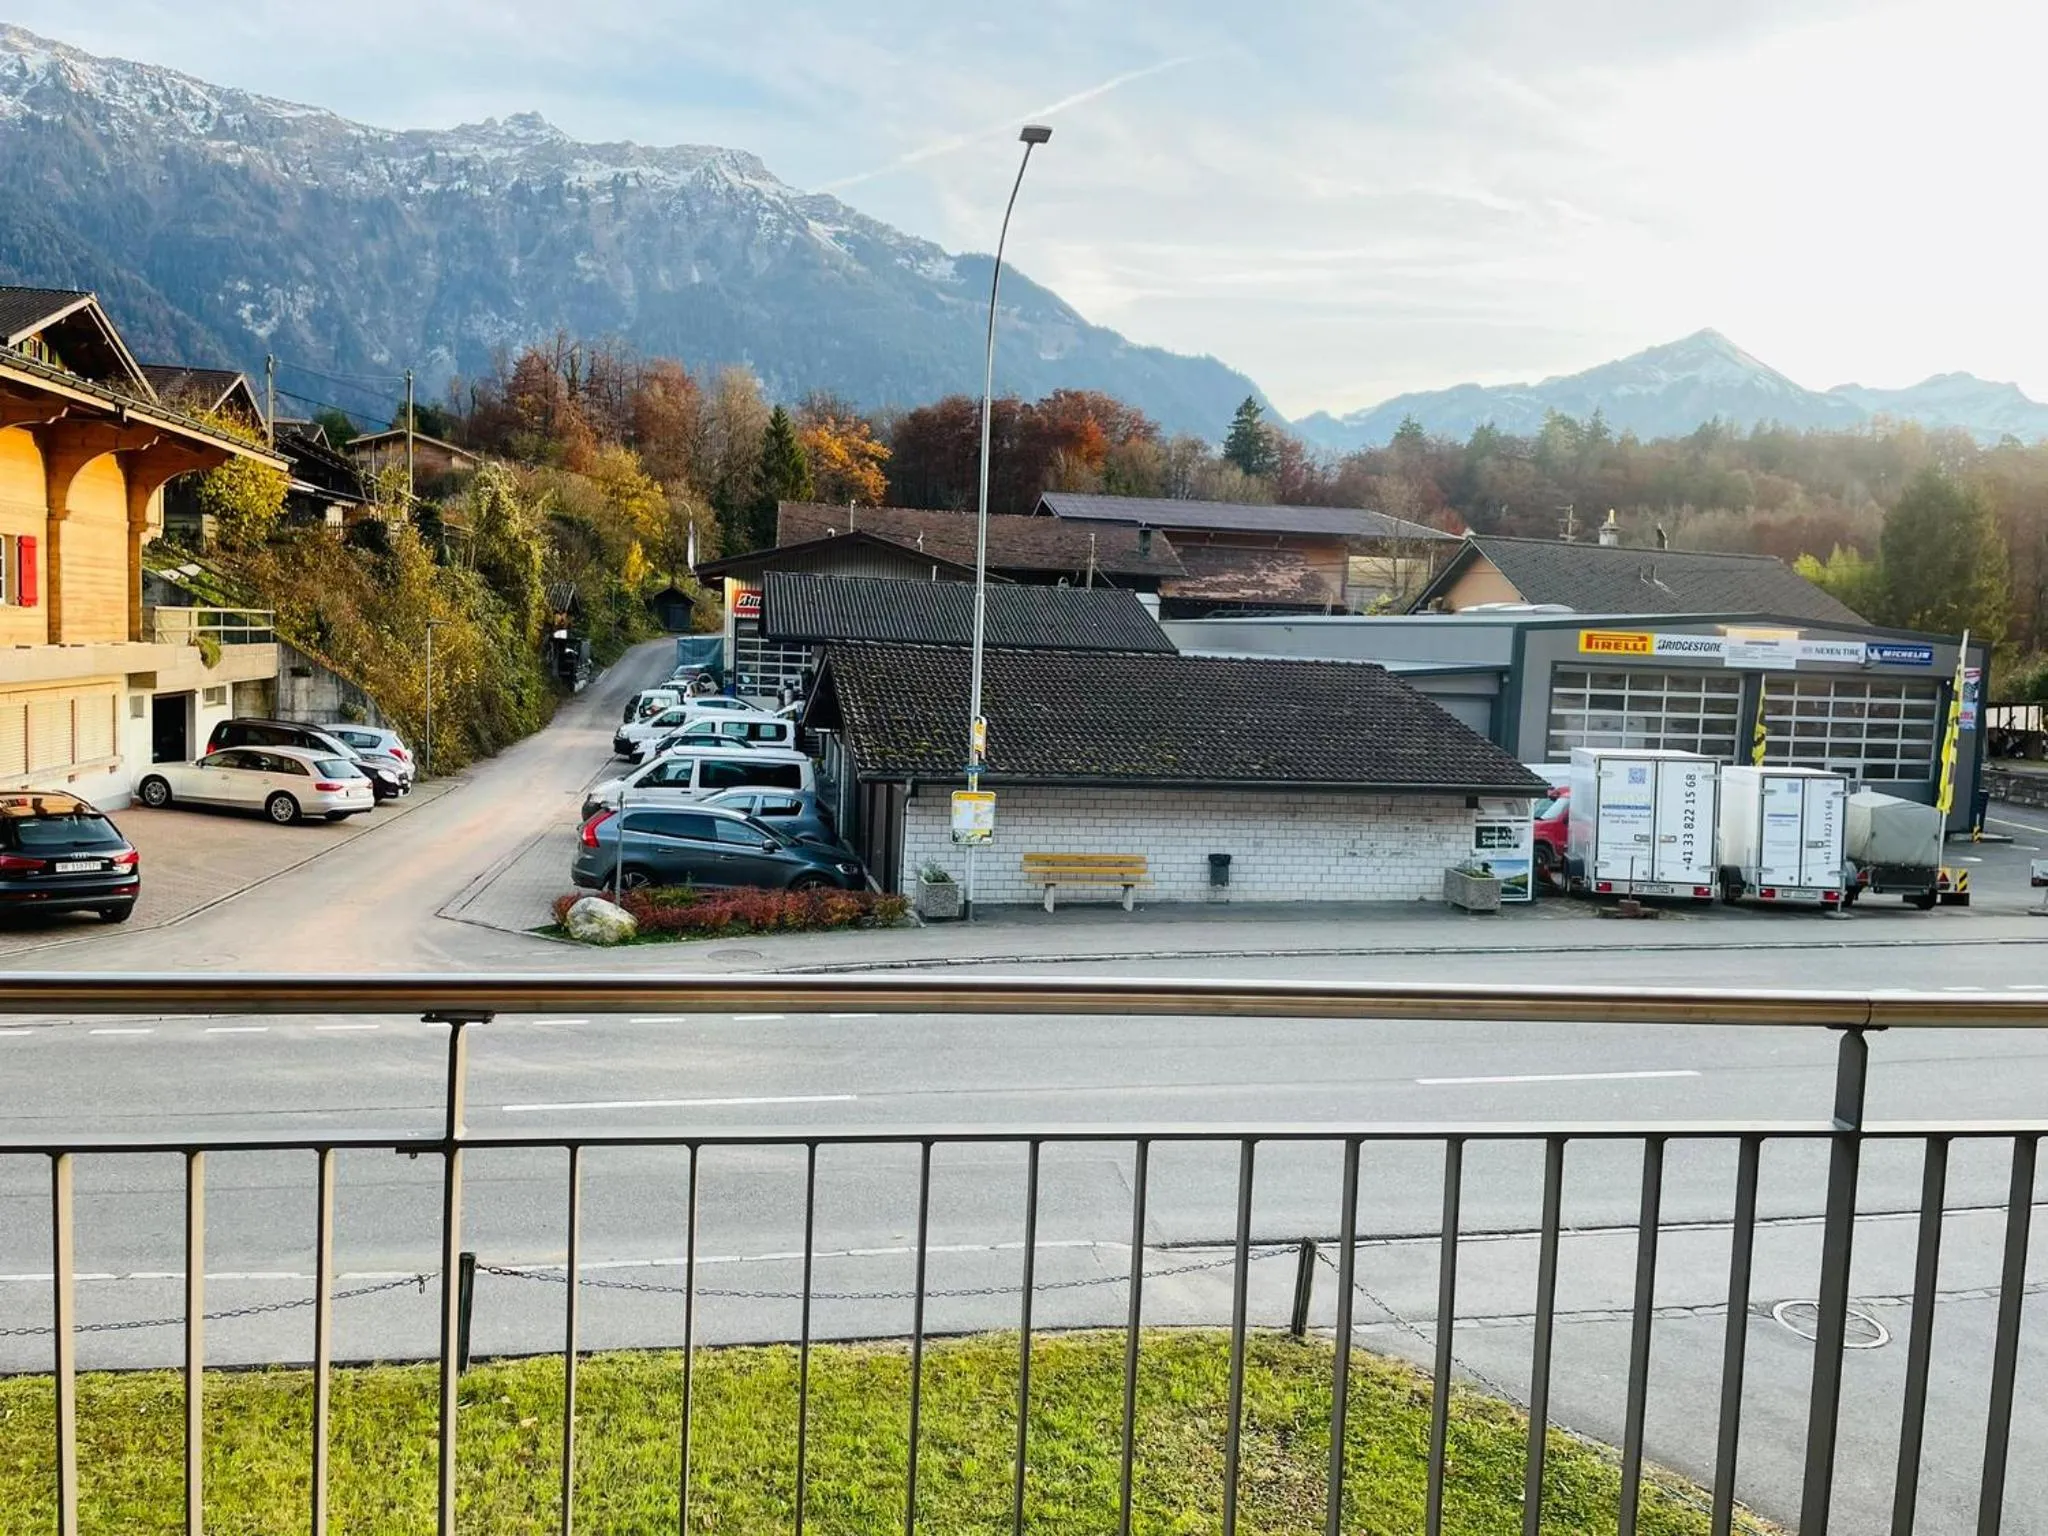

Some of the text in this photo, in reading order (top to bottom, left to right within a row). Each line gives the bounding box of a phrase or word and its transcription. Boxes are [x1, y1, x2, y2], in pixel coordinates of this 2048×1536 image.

[1585, 633, 1648, 652] PIRELLI
[1657, 639, 1722, 653] BRIDGESTONE
[1882, 650, 1930, 659] MICHELIN
[1685, 773, 1697, 788] 68
[1685, 791, 1696, 805] 15
[1684, 808, 1695, 830] 822
[1683, 833, 1694, 847] 33
